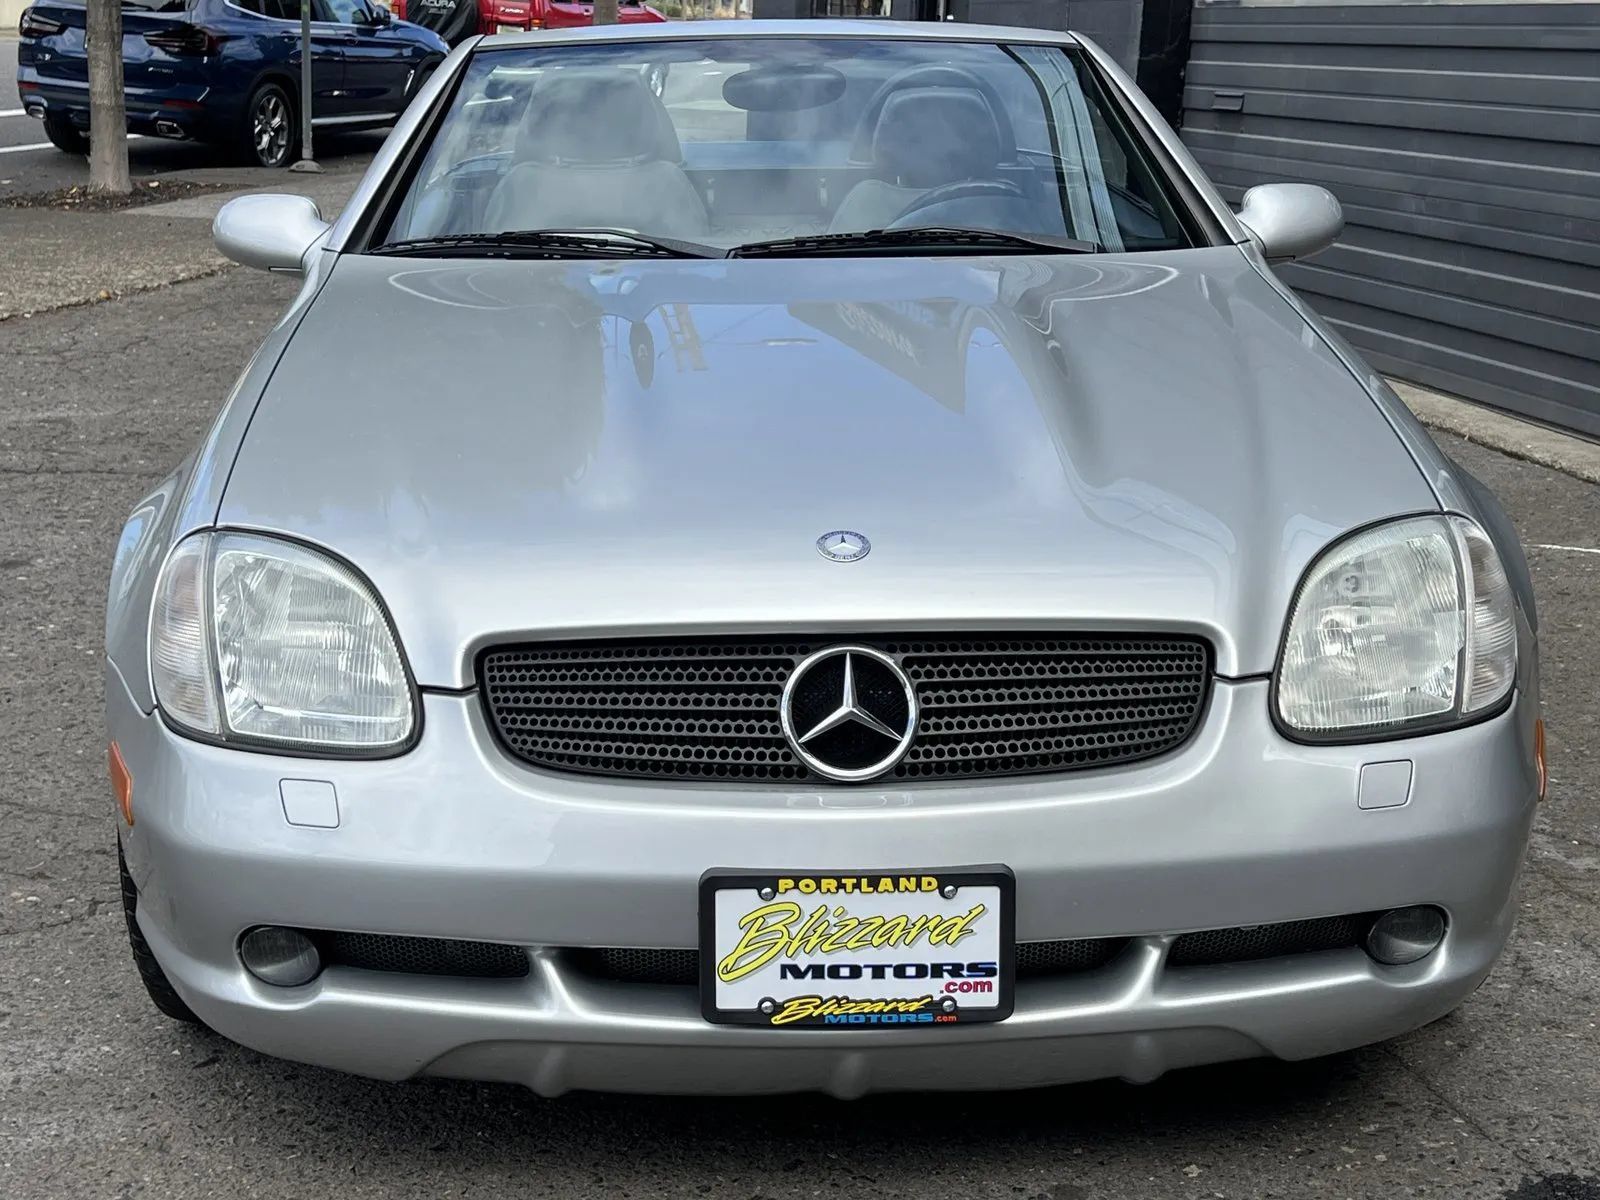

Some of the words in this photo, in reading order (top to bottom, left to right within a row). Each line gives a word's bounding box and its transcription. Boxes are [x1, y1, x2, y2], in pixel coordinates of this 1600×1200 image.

[778, 876, 938, 894] PORTLAND
[717, 901, 985, 983] Blizzard
[780, 962, 998, 980] MOTORS
[940, 981, 993, 994] .com
[771, 997, 932, 1025] Blizzard
